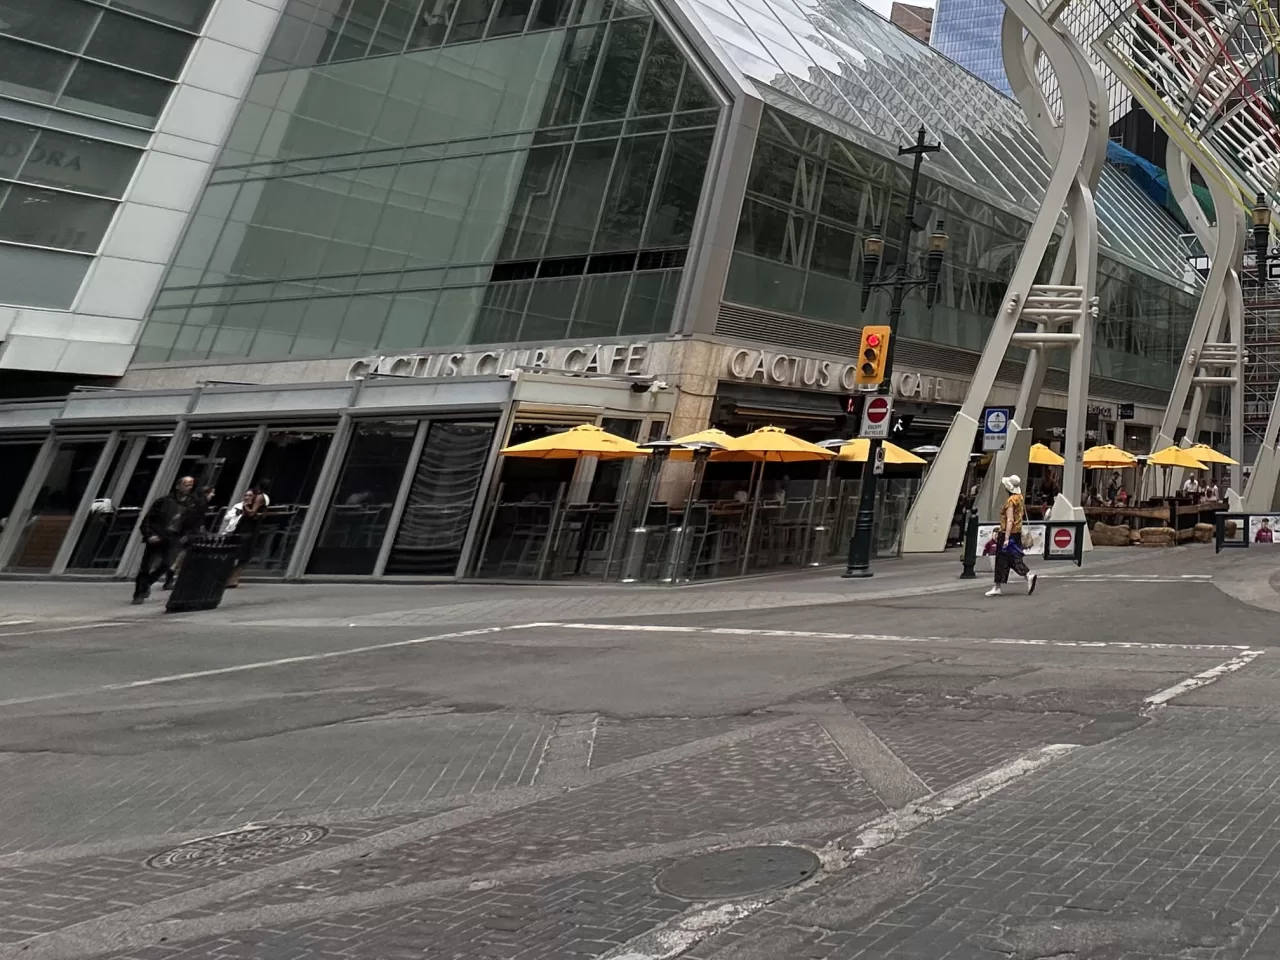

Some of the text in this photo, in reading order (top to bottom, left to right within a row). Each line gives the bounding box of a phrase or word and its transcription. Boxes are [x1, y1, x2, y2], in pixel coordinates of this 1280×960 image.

[345, 352, 464, 381] CACTUS
[730, 349, 831, 387] CACTUS
[900, 372, 944, 400] CAFE
